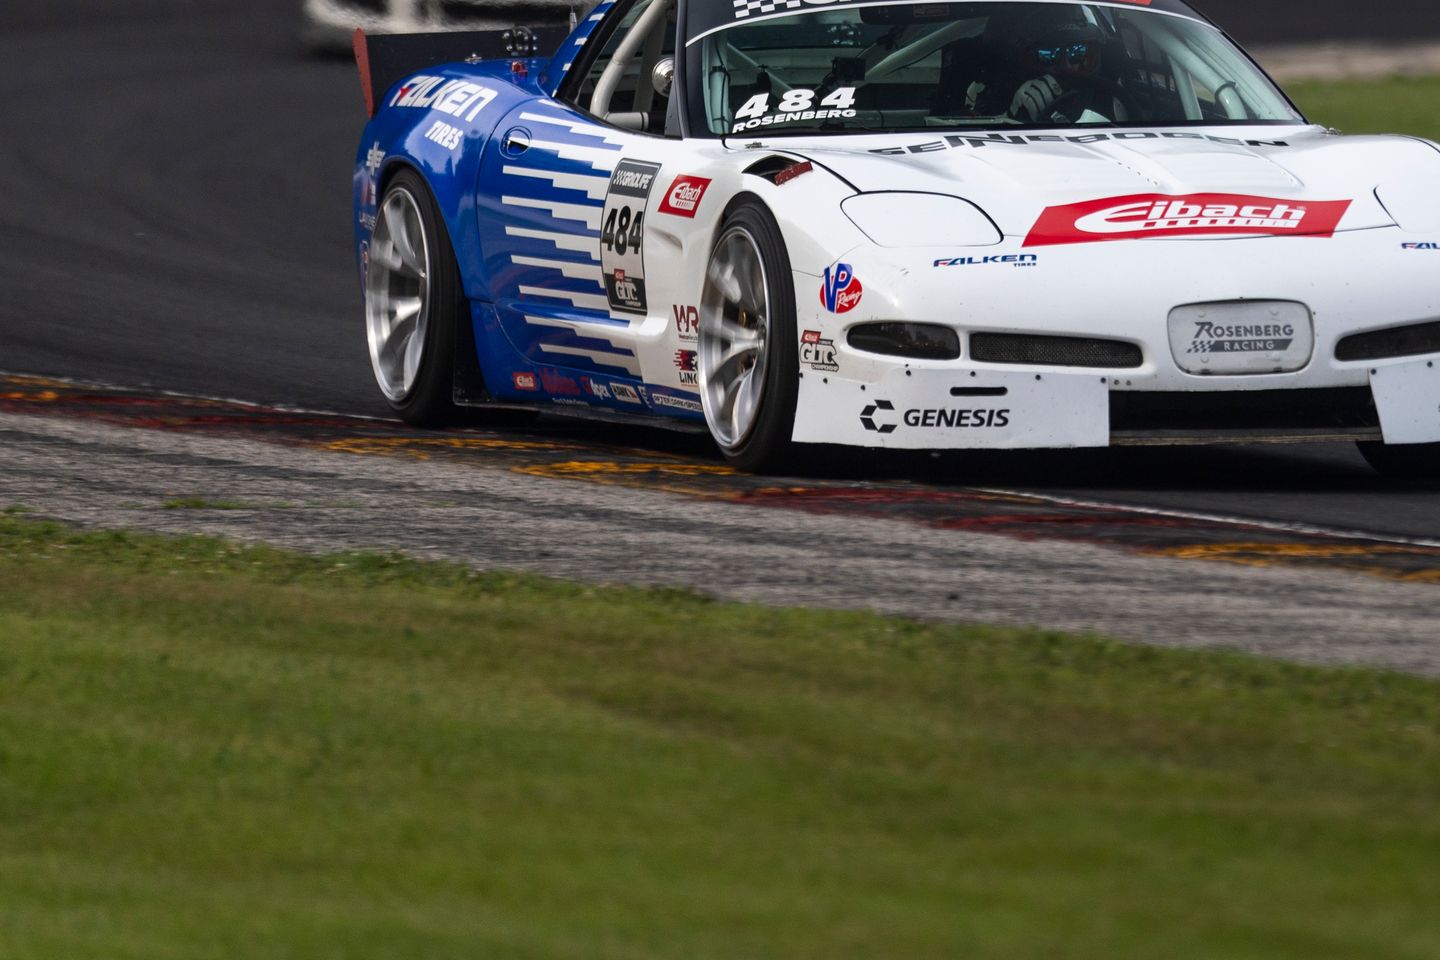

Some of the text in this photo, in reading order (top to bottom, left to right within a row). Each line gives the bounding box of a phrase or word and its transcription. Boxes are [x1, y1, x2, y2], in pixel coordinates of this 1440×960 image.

[389, 75, 498, 122] FALKEN
[735, 86, 857, 120] 484
[425, 120, 464, 151] TIRES
[732, 109, 857, 134] ROSENBERG
[602, 205, 644, 256] 484
[1074, 200, 1306, 234] Eibach
[933, 254, 1037, 268] FALKEN
[823, 263, 854, 314] VP
[837, 290, 862, 310] Racing
[1194, 321, 1294, 339] ROSENBERG
[1223, 341, 1275, 351] RACING
[903, 408, 1010, 428] GENESIS
